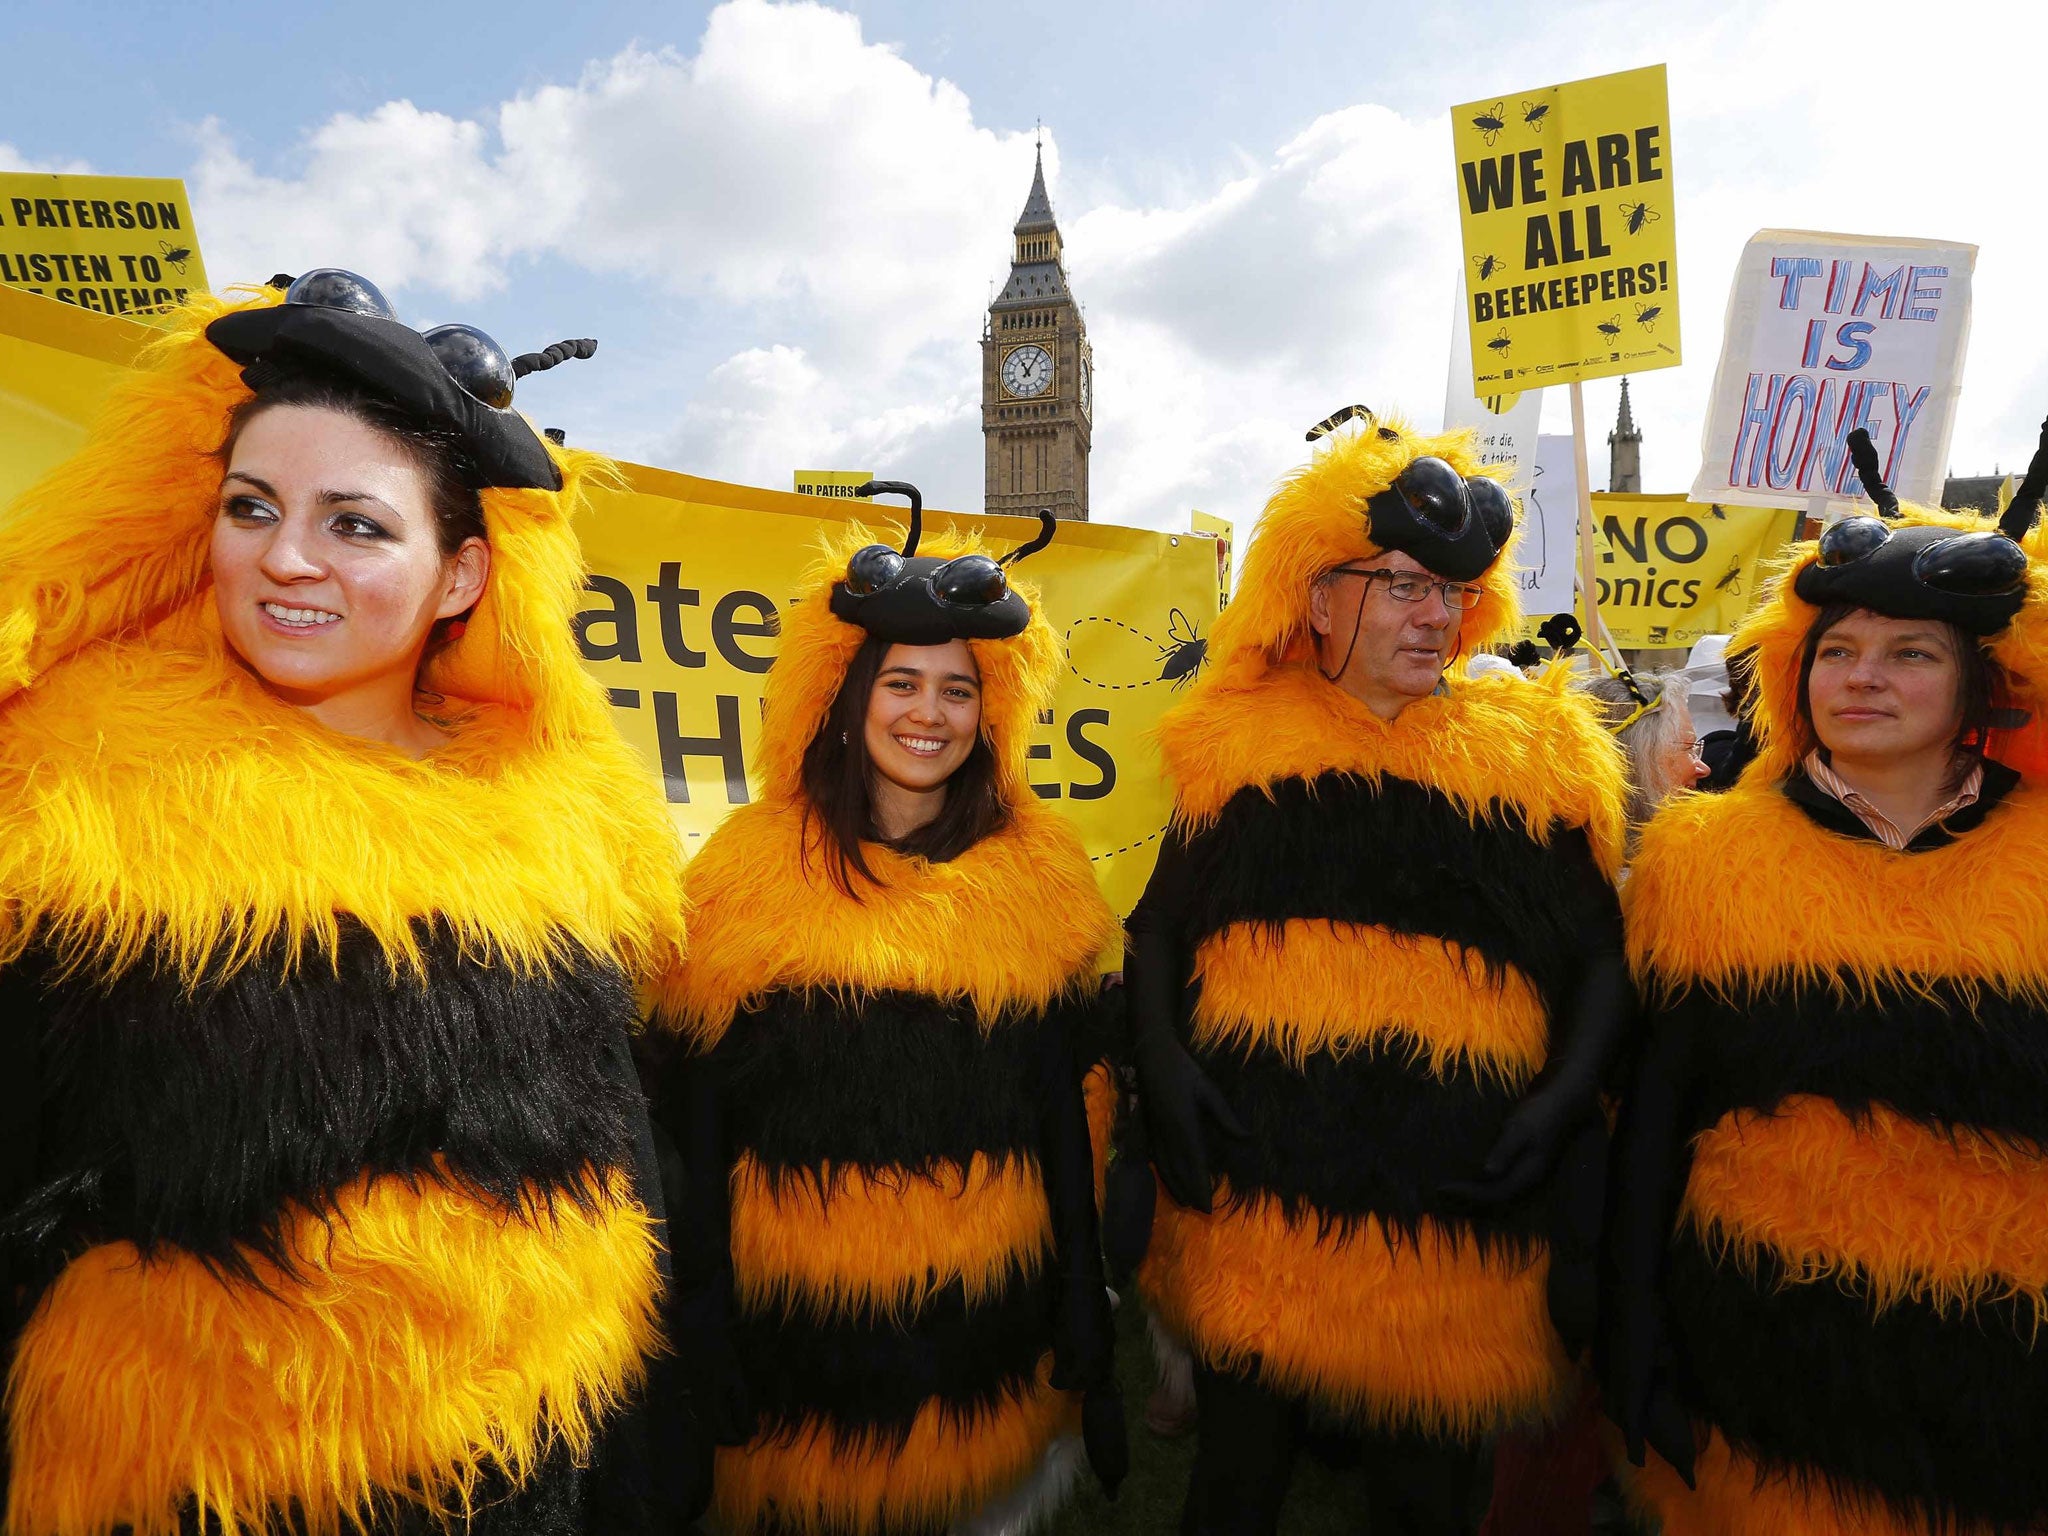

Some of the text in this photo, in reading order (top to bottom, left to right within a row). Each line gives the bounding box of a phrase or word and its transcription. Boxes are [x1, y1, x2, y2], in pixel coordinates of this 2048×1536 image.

[1461, 125, 1663, 214] WE ARE
[11, 198, 180, 230] PATERSON
[1524, 204, 1611, 271] ALL
[1, 253, 162, 283] LISTEN TO
[1473, 260, 1668, 323] BEEKEEPERS!
[1771, 257, 1949, 322] TIME
[1801, 319, 1876, 371] IS
[1729, 372, 1931, 499] HONEY
[797, 484, 862, 497] MR PATERSO
[1602, 515, 1708, 564] NO
[570, 562, 806, 674] ate
